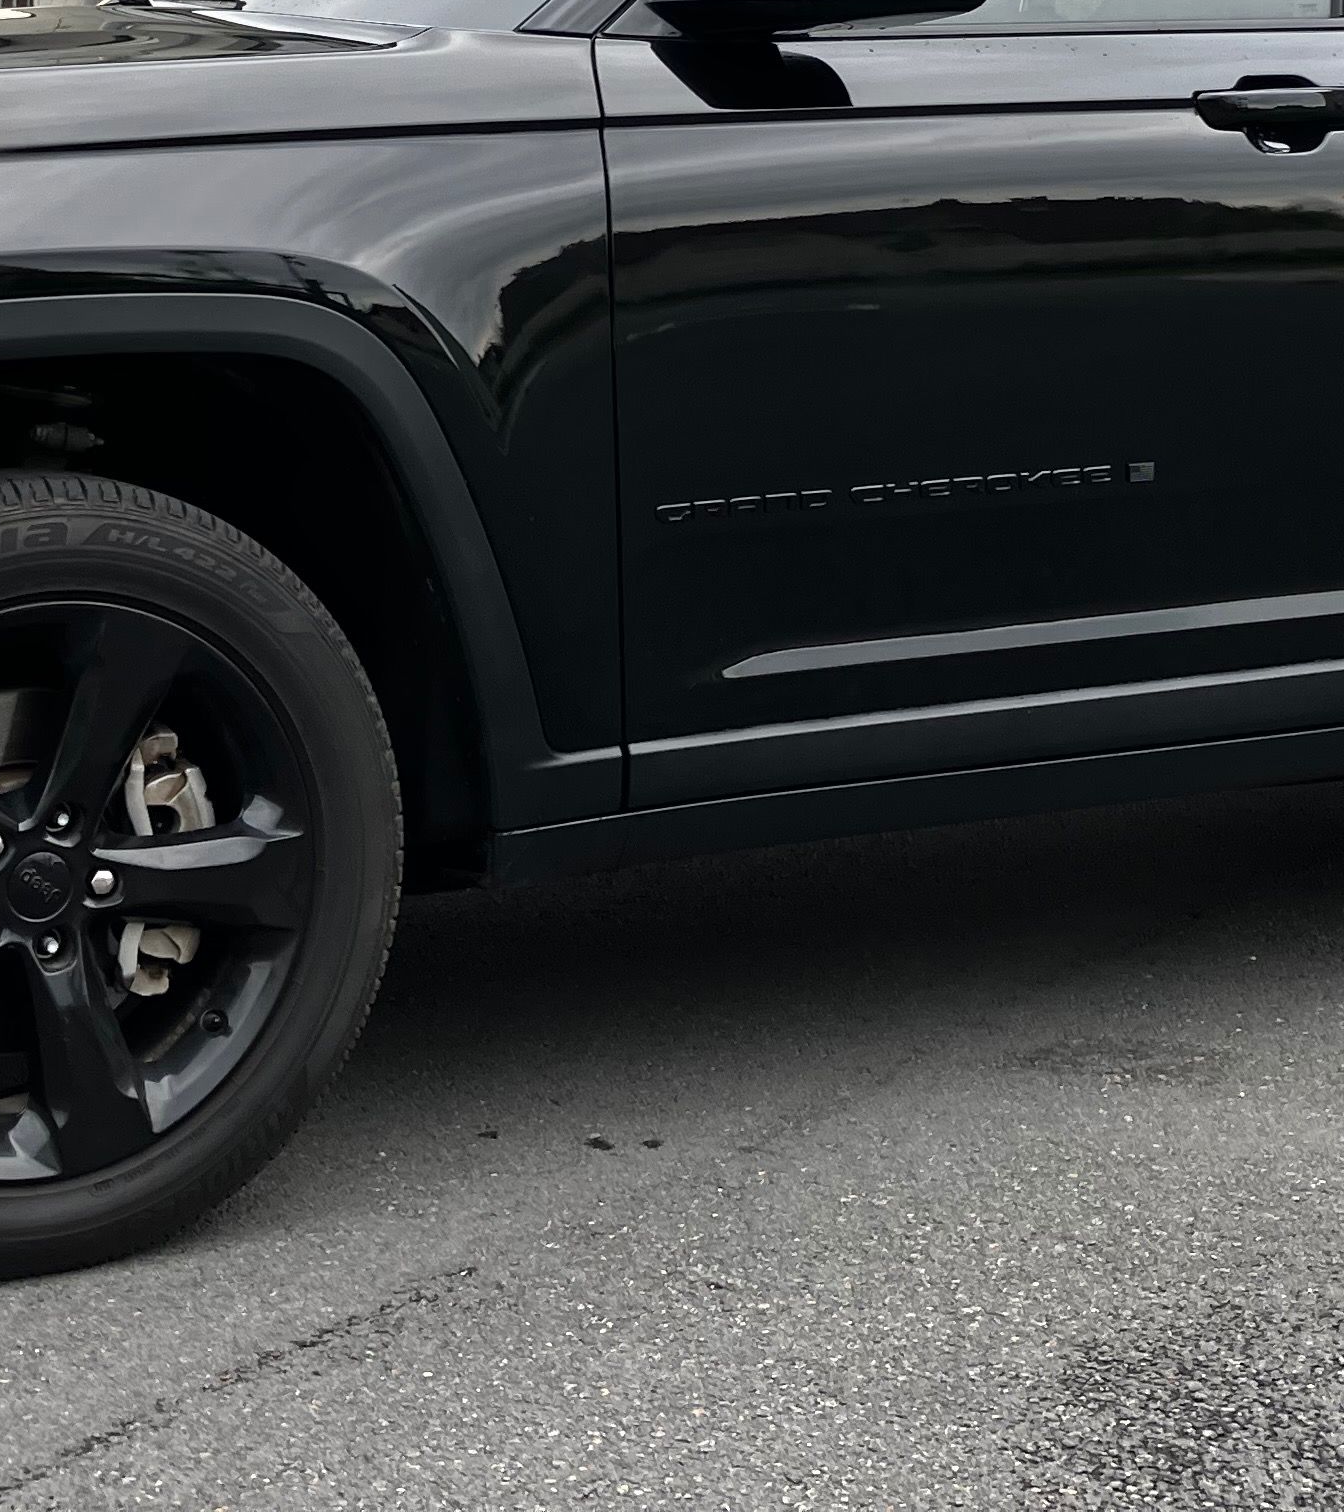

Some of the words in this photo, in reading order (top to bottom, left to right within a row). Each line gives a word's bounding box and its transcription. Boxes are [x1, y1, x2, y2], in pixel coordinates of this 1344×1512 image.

[655, 489, 833, 525] GRAND
[850, 464, 1113, 505] CHEROKEE
[175, 546, 238, 582] 422
